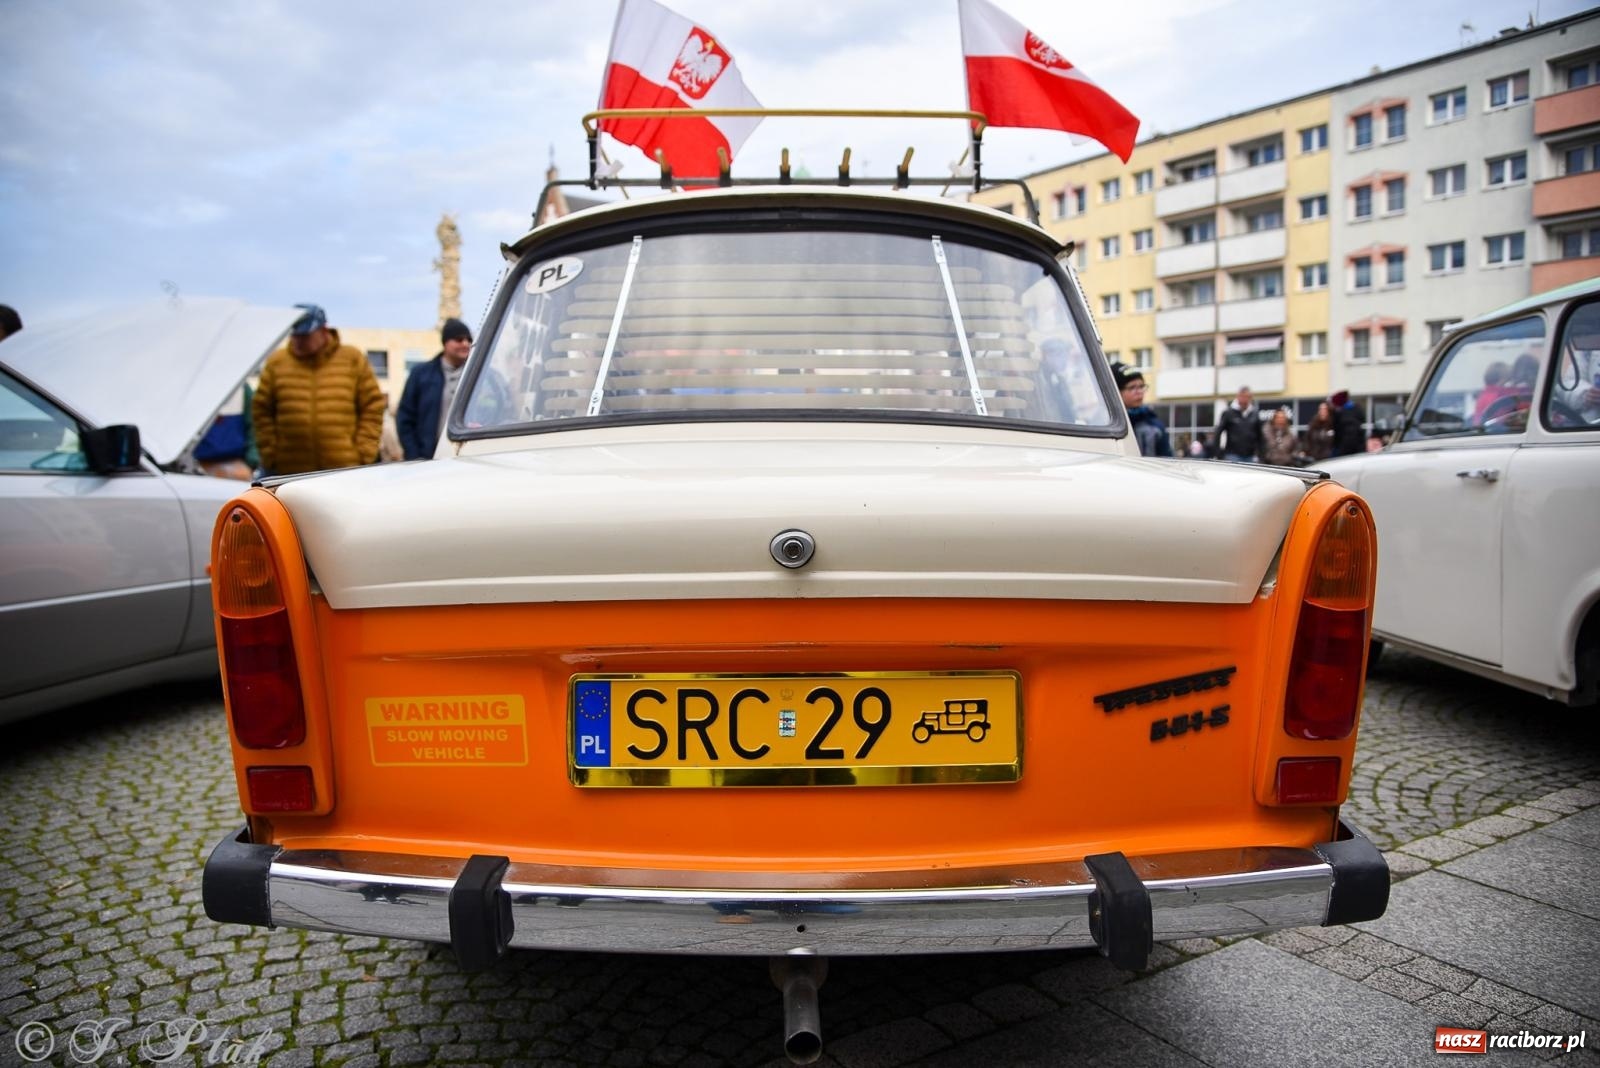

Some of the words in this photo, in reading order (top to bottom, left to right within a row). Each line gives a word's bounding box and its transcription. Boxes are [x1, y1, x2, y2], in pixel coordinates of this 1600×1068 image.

[539, 263, 568, 288] PL
[380, 701, 510, 721] WARNING
[626, 687, 770, 760] SRC
[805, 686, 891, 760] 29
[387, 730, 434, 742] SLOW
[439, 729, 508, 741] MOVING
[581, 735, 606, 754] PL
[412, 747, 486, 759] VEHICLE
